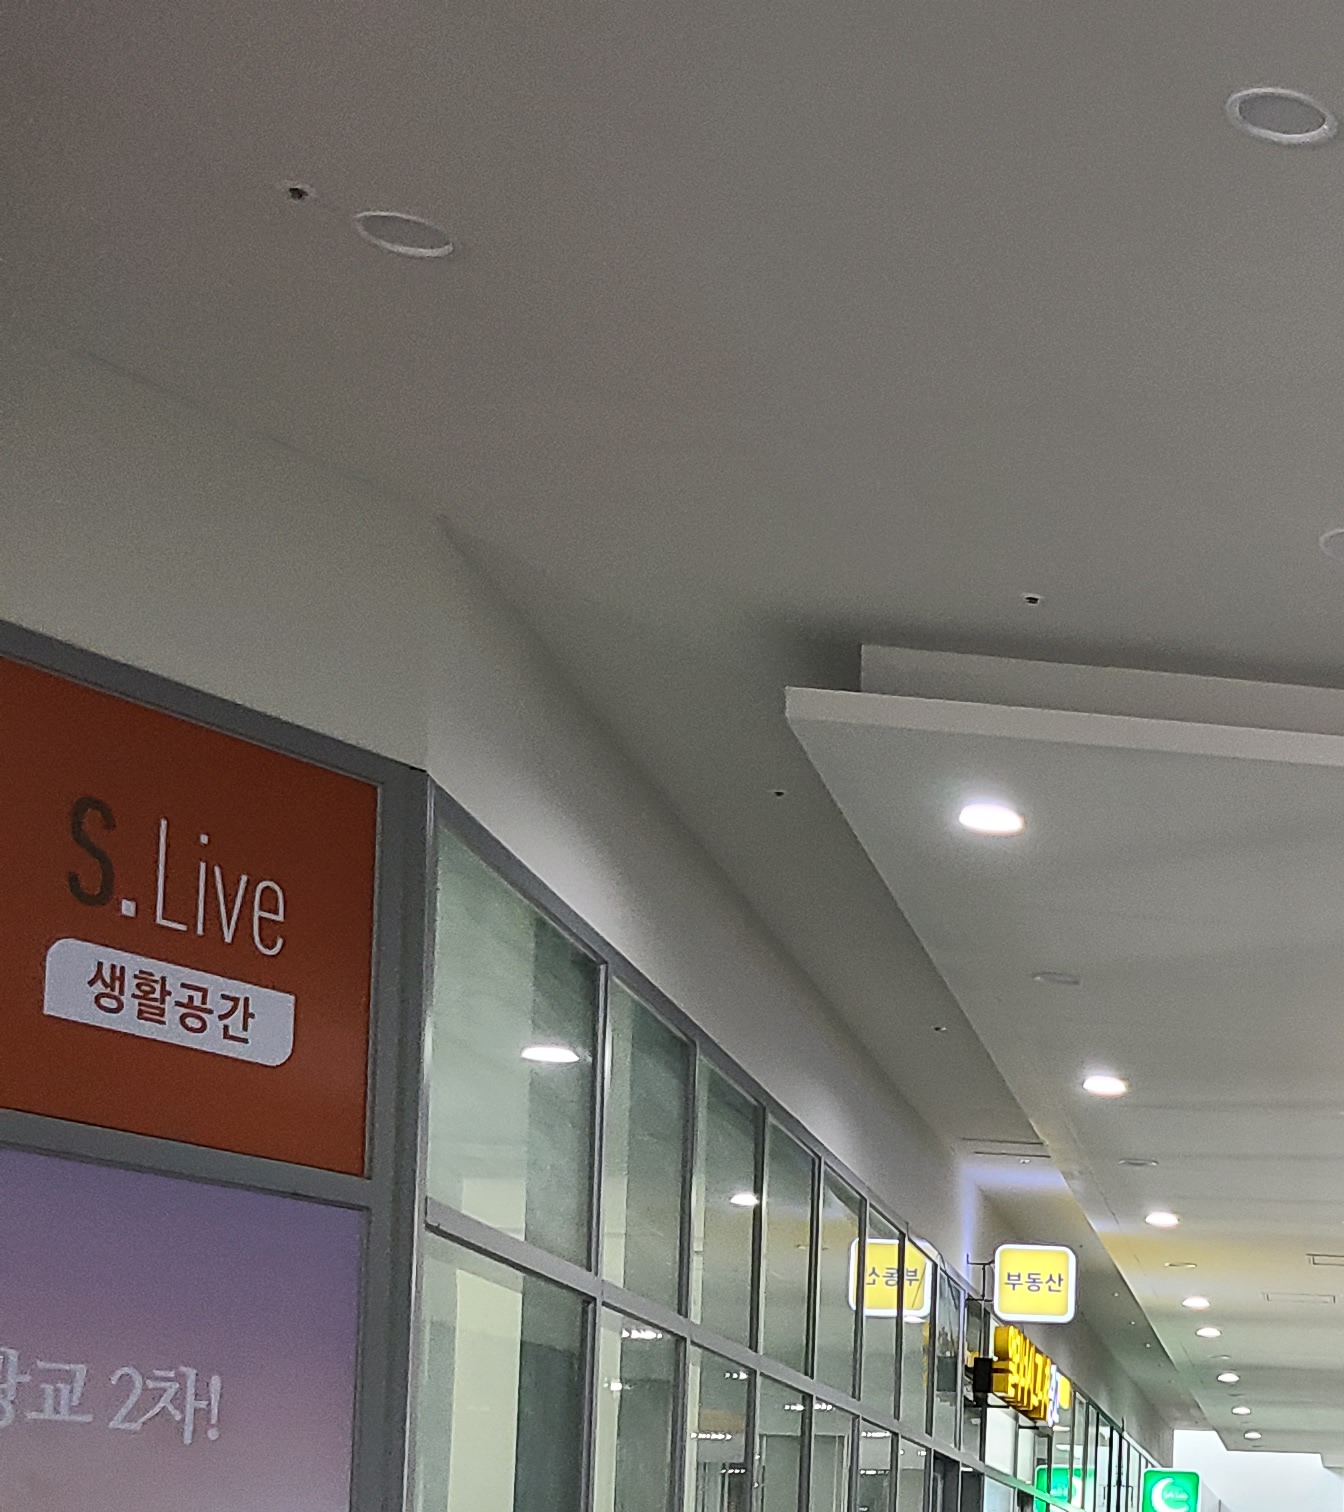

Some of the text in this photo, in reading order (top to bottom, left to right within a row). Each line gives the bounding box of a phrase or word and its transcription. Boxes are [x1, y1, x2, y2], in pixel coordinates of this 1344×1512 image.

[67, 797, 285, 957] S.Live
[87, 960, 255, 1044] 생활공간
[1004, 1271, 1064, 1293] 부동산
[108, 1364, 222, 1445] 2차!
